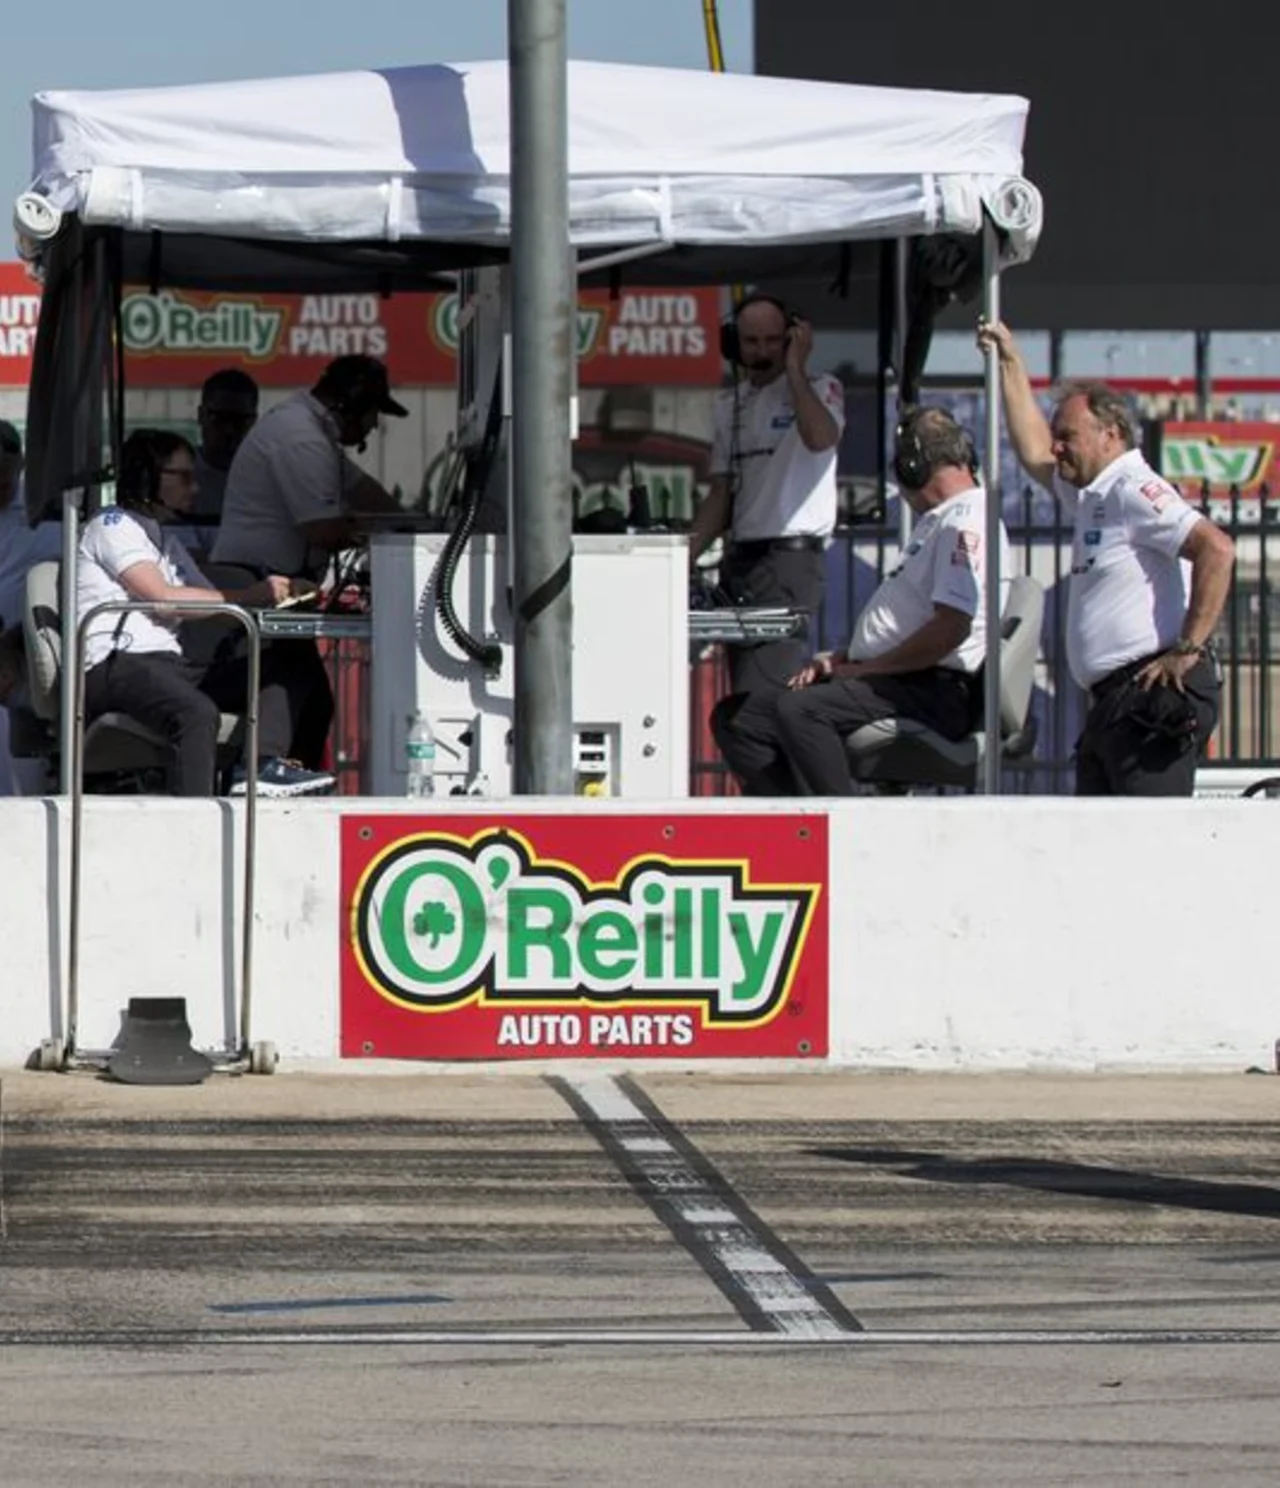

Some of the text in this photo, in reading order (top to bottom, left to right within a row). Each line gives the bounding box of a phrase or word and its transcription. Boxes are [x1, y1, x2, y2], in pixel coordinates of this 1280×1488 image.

[121, 292, 278, 352] O'Reilly
[300, 295, 379, 324] AUTO
[619, 295, 697, 325] AUTO
[291, 326, 387, 356] PARTS
[609, 326, 706, 356] PARTS
[379, 855, 785, 1000] O'Reilly
[496, 1014, 694, 1046] AUTO PARTS
